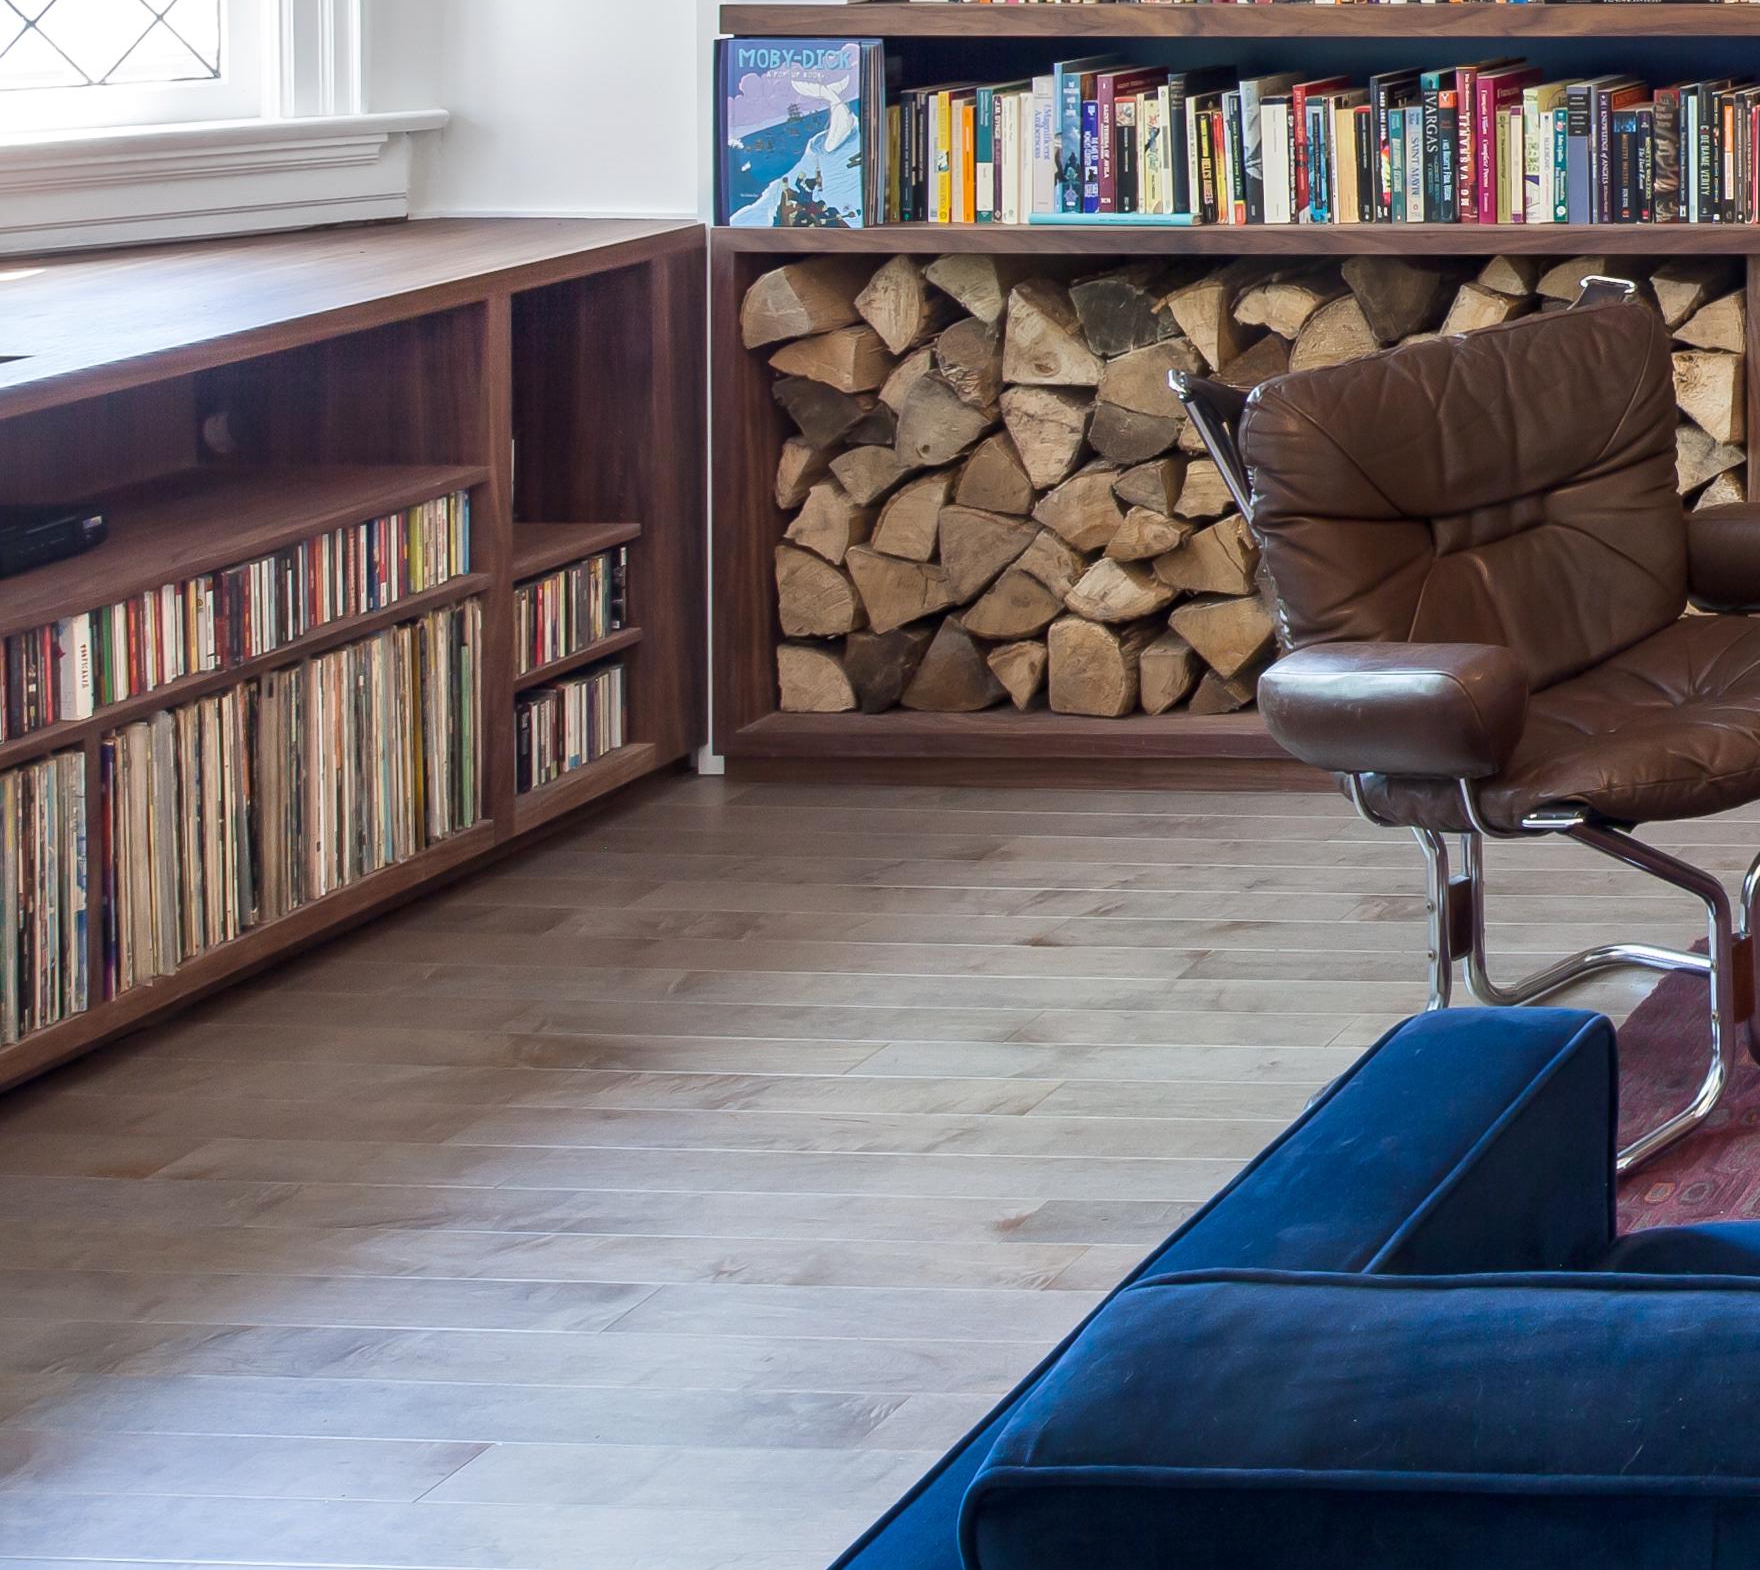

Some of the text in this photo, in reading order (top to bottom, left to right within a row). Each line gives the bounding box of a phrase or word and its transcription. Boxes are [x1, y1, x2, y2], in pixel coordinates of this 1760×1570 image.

[739, 49, 853, 70] MOBY-DICK
[1042, 109, 1051, 160] Magnificent
[1425, 96, 1439, 152] VARGAS
[1410, 137, 1420, 198] SAINT MAYBE
